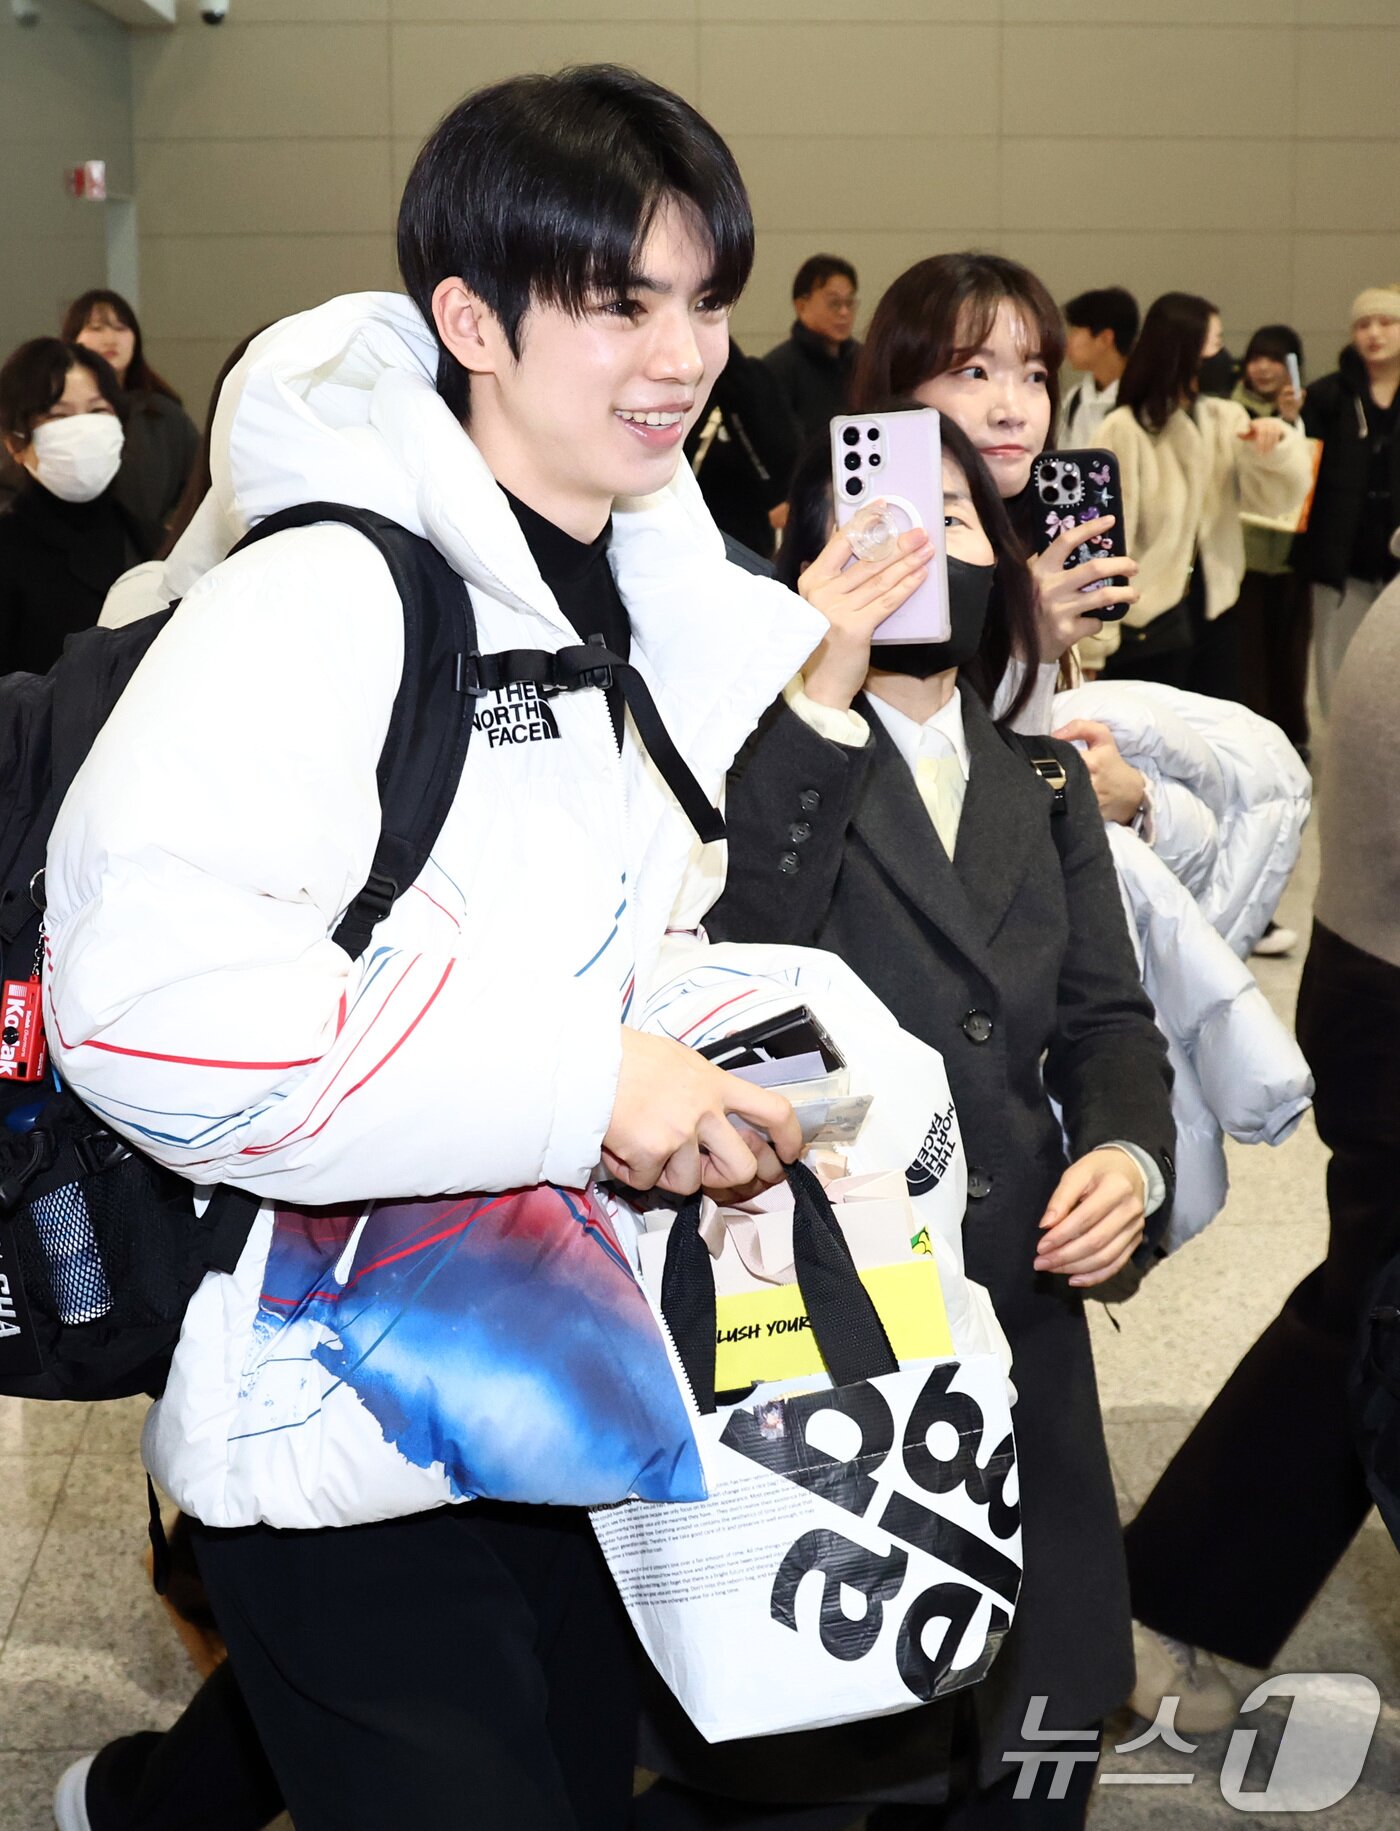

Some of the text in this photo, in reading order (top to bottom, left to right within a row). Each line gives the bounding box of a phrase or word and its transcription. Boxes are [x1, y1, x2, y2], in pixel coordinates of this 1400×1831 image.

[488, 681, 536, 704] THE
[473, 700, 539, 731] NORTH
[487, 722, 542, 748] FACE
[0, 998, 26, 1076] Koak
[917, 1112, 943, 1162] FACE
[926, 1101, 954, 1170] NORTH
[934, 1142, 956, 1178] THE
